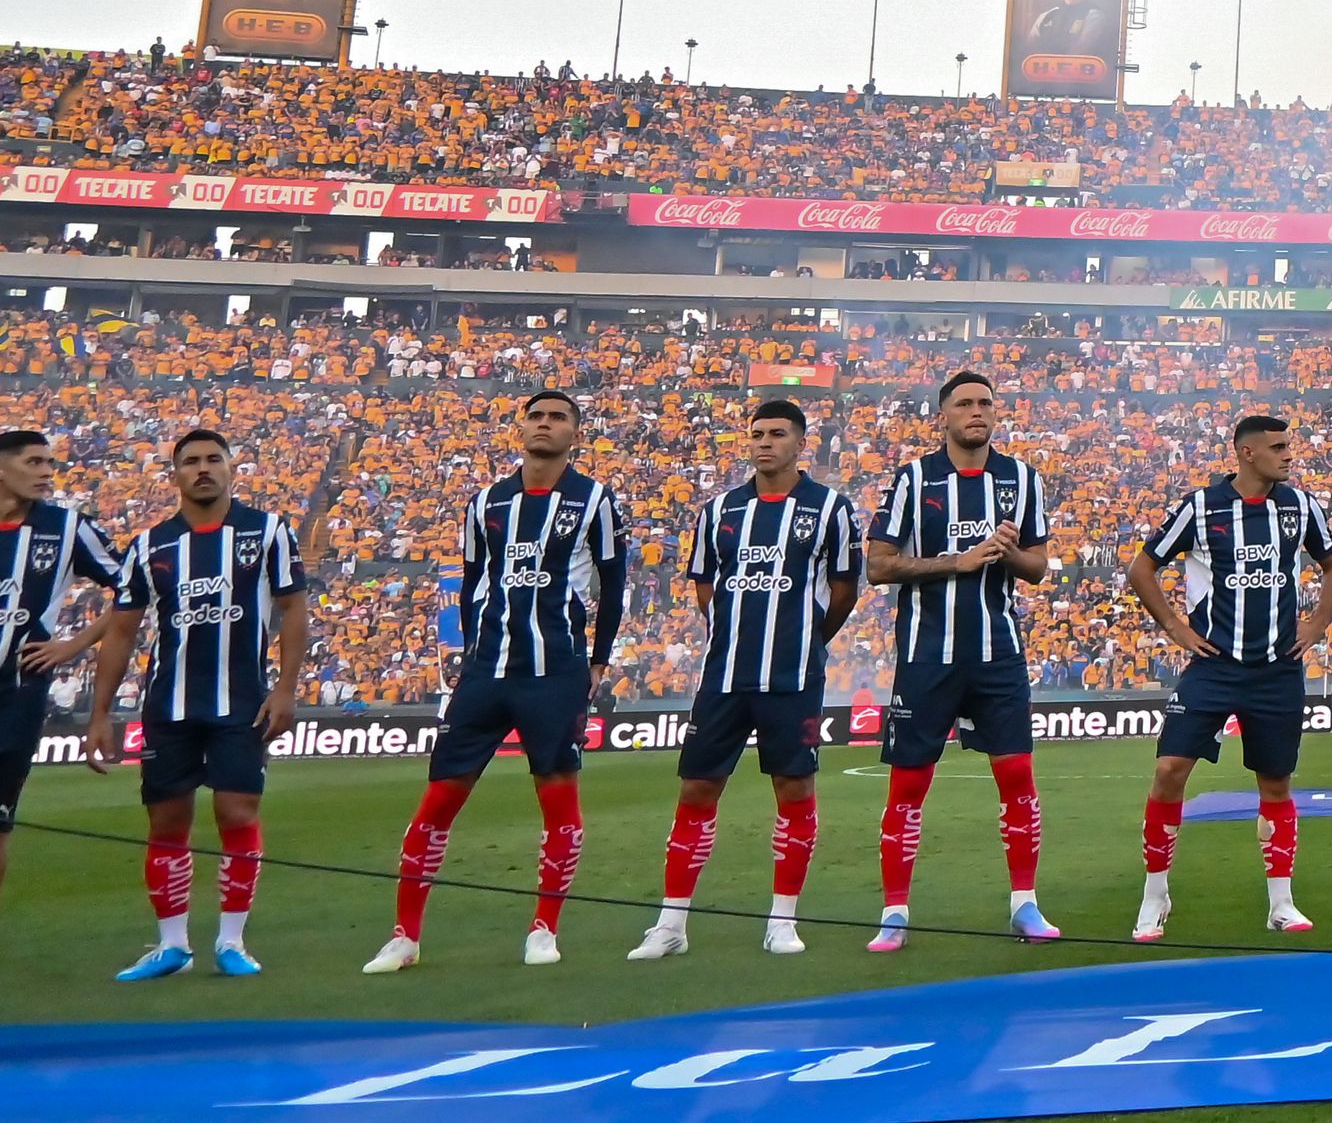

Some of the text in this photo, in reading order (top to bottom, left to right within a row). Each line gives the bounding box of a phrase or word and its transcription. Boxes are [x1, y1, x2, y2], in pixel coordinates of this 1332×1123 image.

[75, 178, 156, 200] TECATE
[240, 184, 319, 206] TECATE
[400, 192, 474, 212] TECATE
[654, 197, 747, 225] Coca-Cola
[798, 202, 885, 230] Coca-Cola
[936, 205, 1021, 234] Coca-Cola
[1211, 291, 1296, 309] AFIRME
[947, 520, 995, 538] BBVA
[504, 540, 545, 559] BBVA
[738, 545, 784, 563] BBVA
[1235, 544, 1280, 562] BBVA
[179, 577, 232, 597] BBVA
[726, 572, 792, 592] codere
[1225, 568, 1287, 589] codere
[171, 603, 244, 628] codere
[213, 1042, 936, 1107] La
